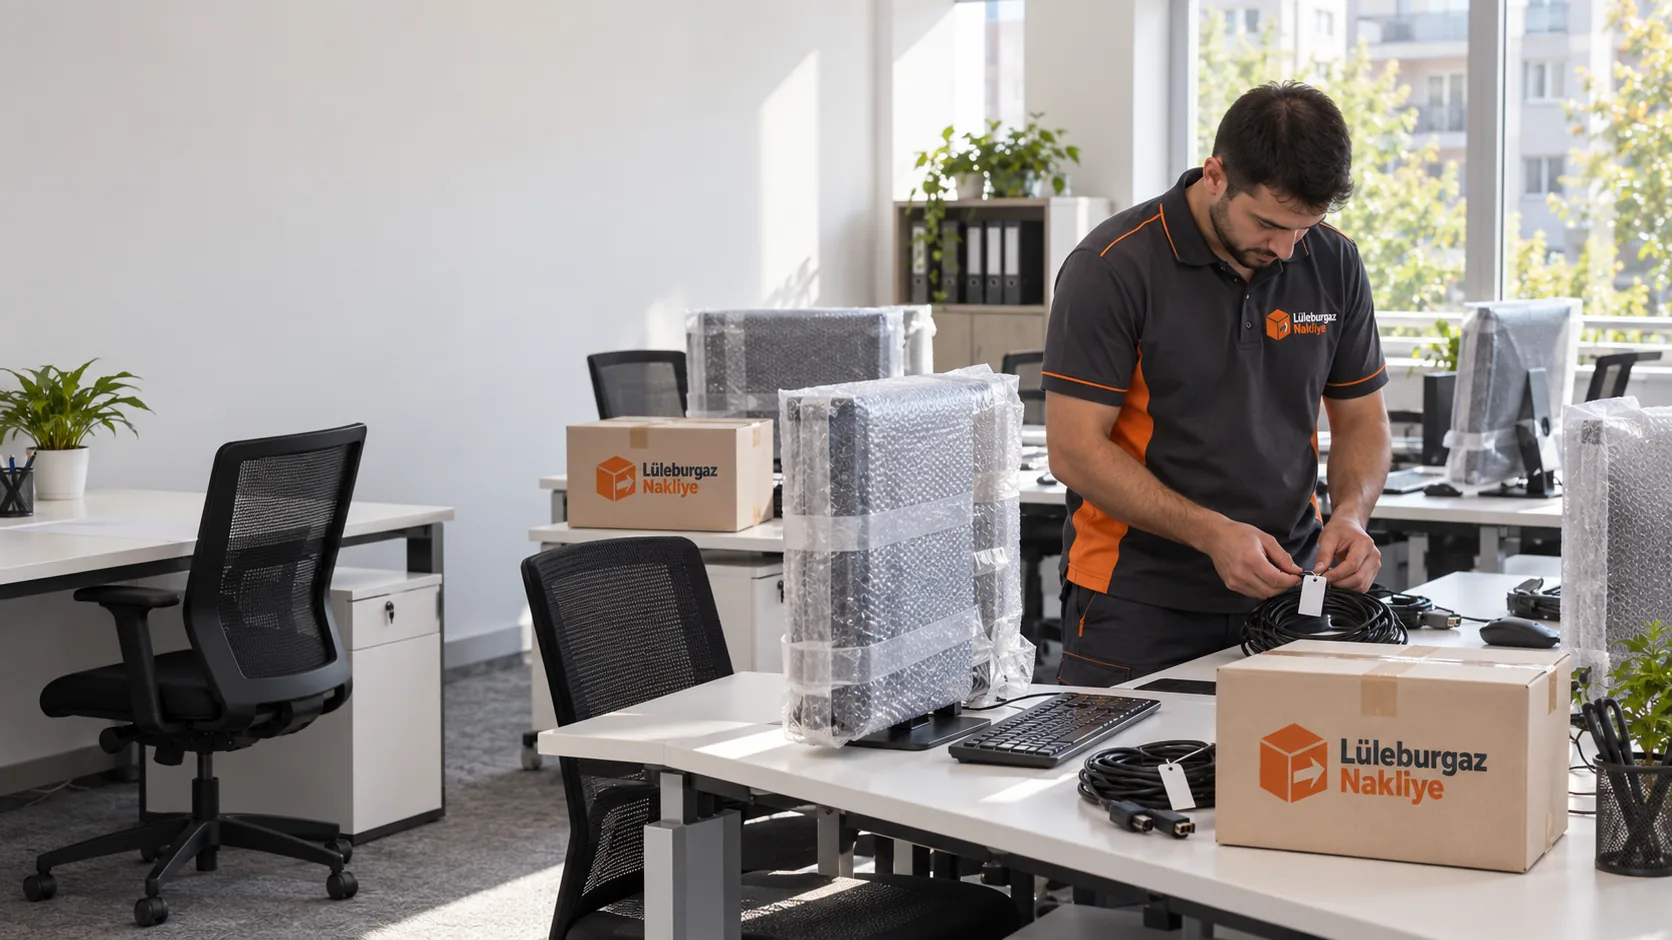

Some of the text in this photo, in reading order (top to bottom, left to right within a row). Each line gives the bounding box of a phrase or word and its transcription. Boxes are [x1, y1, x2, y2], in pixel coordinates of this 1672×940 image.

[1293, 312, 1337, 324] Lüleburgaz
[643, 462, 718, 480] Lüleburgaz
[643, 479, 699, 498] Nakliye
[1340, 738, 1488, 777] Lüleburgaz
[1340, 768, 1444, 805] Nakliye
